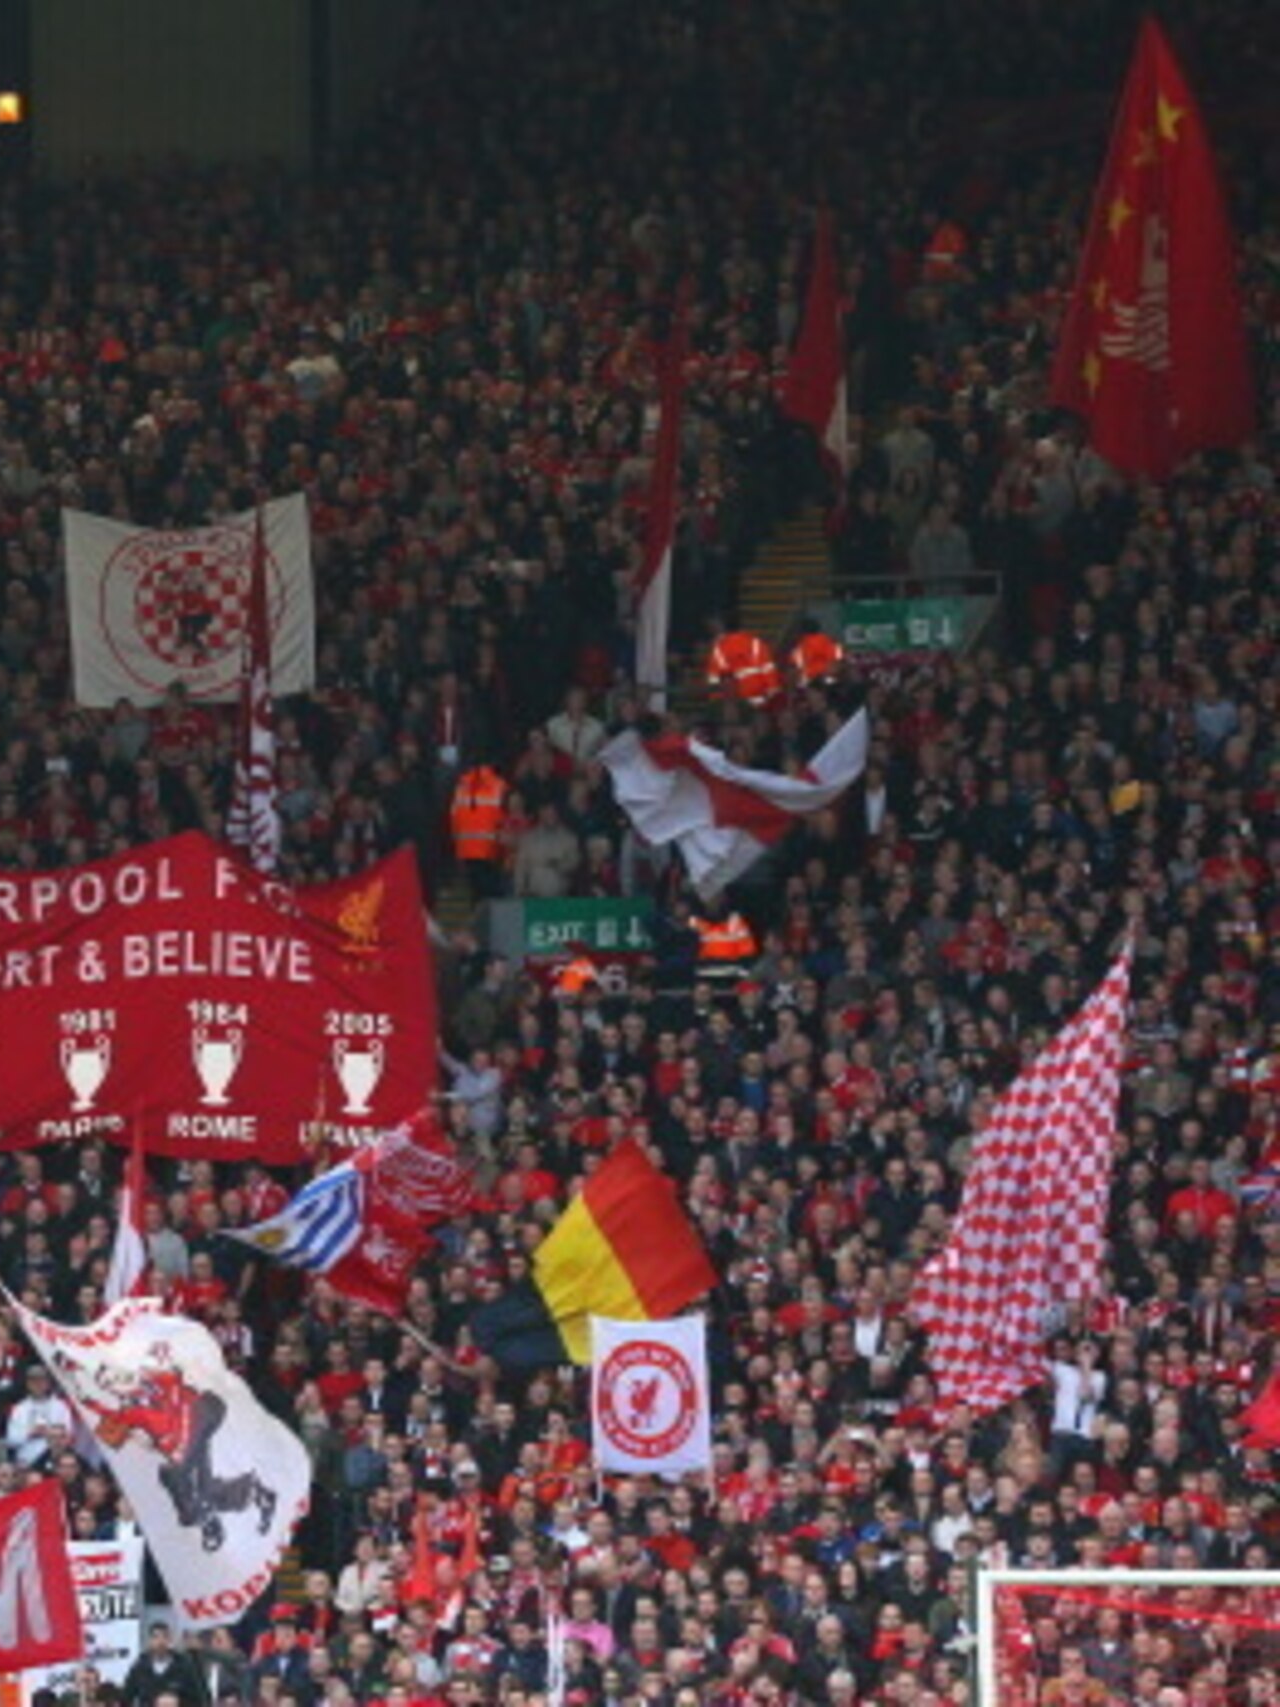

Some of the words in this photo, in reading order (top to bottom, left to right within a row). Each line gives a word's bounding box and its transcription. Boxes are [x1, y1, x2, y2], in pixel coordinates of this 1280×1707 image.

[530, 920, 585, 947] EXIT
[79, 940, 107, 982] &
[123, 930, 314, 982] BELIEVE
[323, 1010, 394, 1036] 2005
[168, 1114, 257, 1142] ROME
